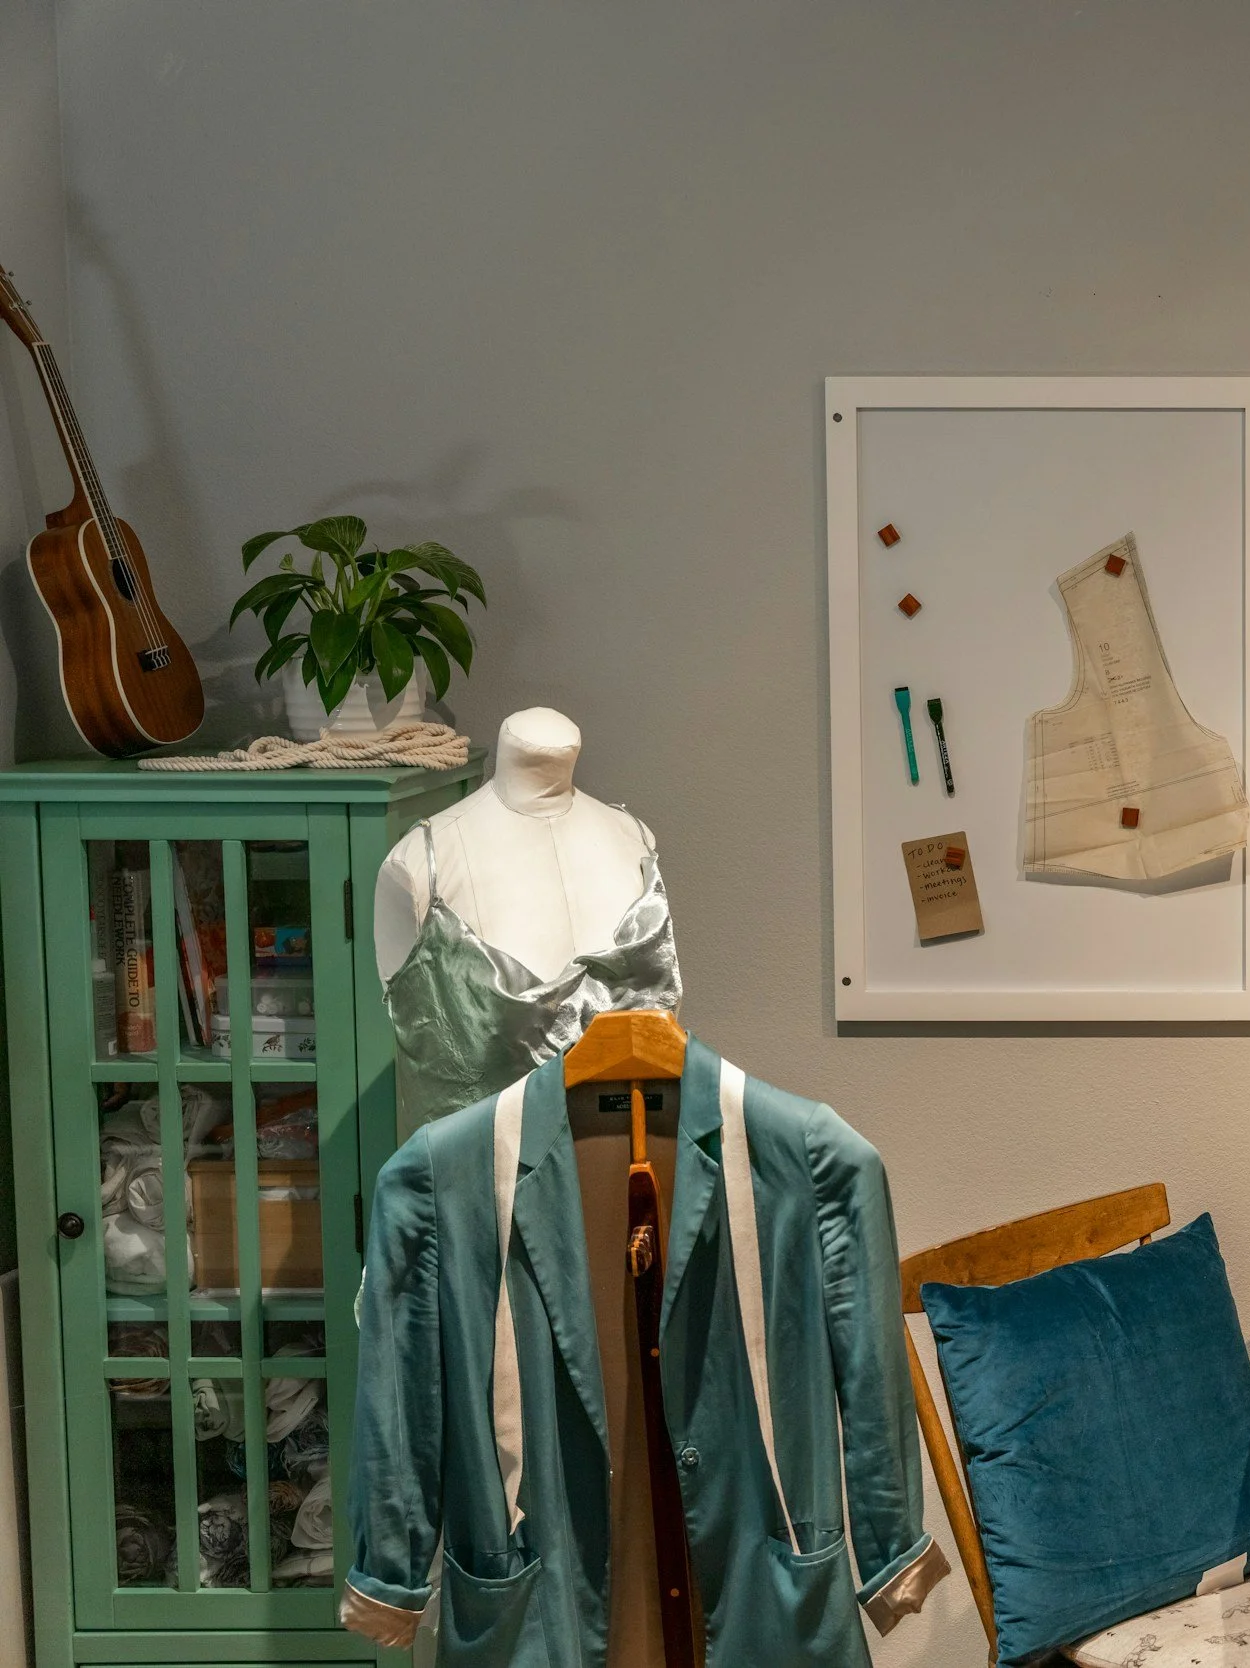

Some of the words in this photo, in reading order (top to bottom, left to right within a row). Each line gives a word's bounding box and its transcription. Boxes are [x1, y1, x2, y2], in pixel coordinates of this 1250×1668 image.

[1099, 642, 1110, 652] 10
[908, 847, 923, 859] TO
[927, 842, 944, 853] DO
[112, 875, 126, 967] NEEDLEWORK
[122, 877, 137, 947] COMPLETE
[126, 949, 139, 988] GUIDE
[128, 990, 140, 1008] TO
